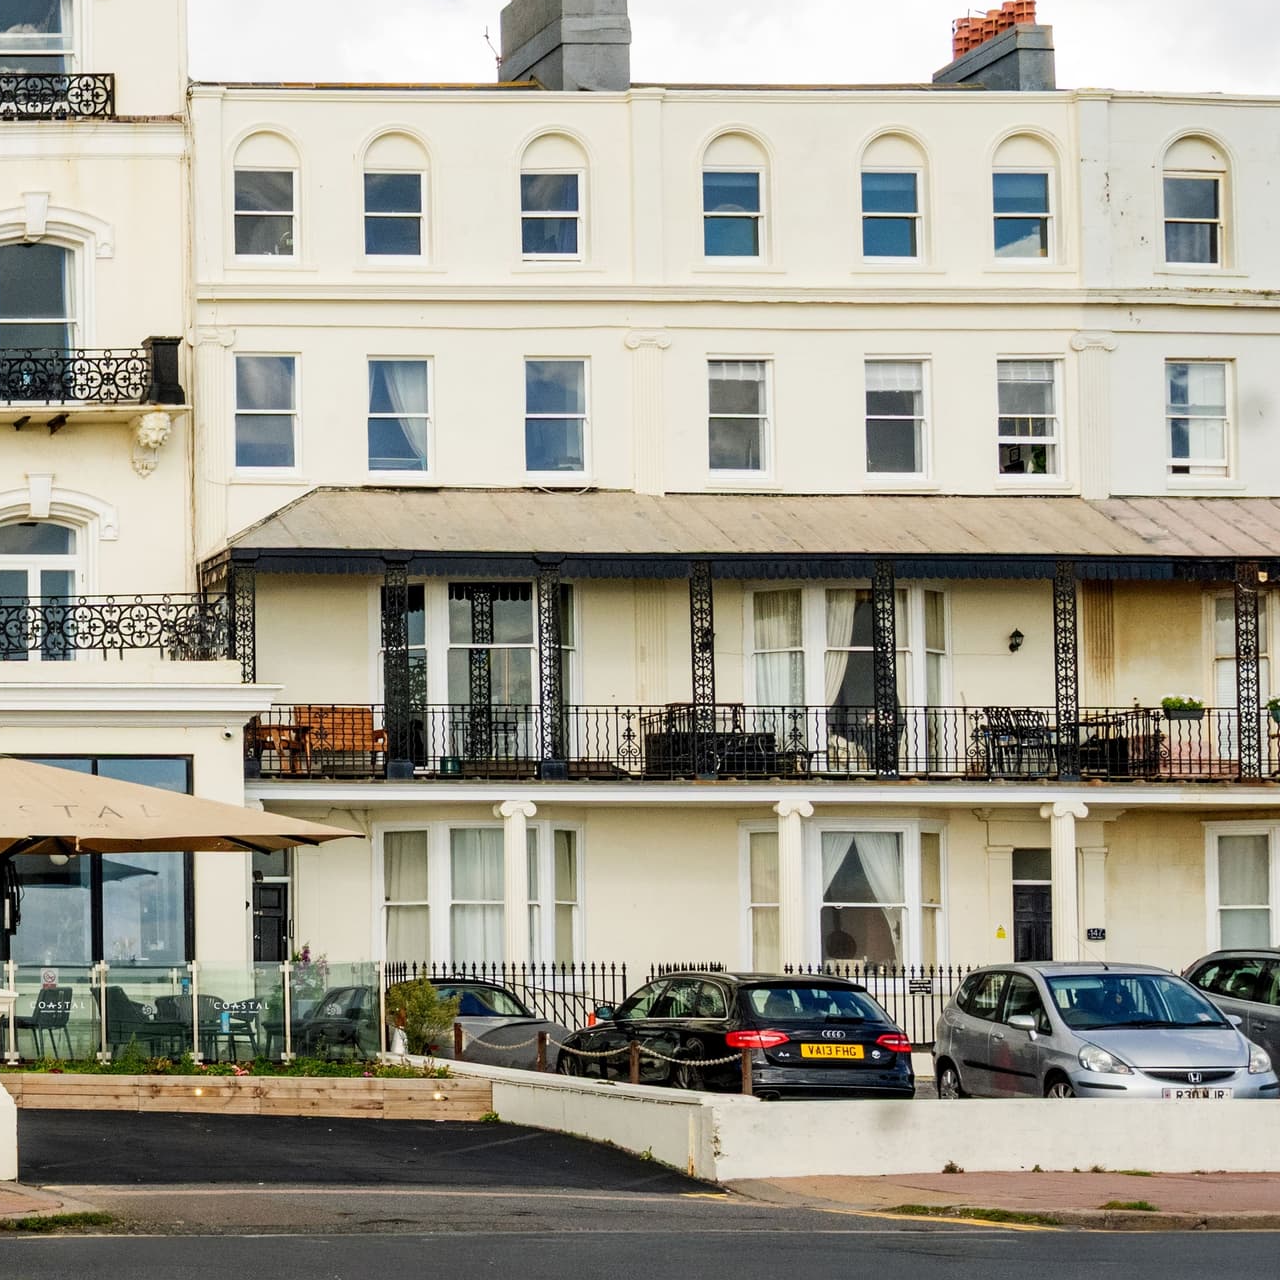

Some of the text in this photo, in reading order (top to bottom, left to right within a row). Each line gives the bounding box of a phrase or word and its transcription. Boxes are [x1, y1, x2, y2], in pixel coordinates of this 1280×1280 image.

[30, 1001, 85, 1009] COASTAL
[213, 1001, 269, 1009] COASTAL
[808, 1045, 856, 1056] VA13 FHG
